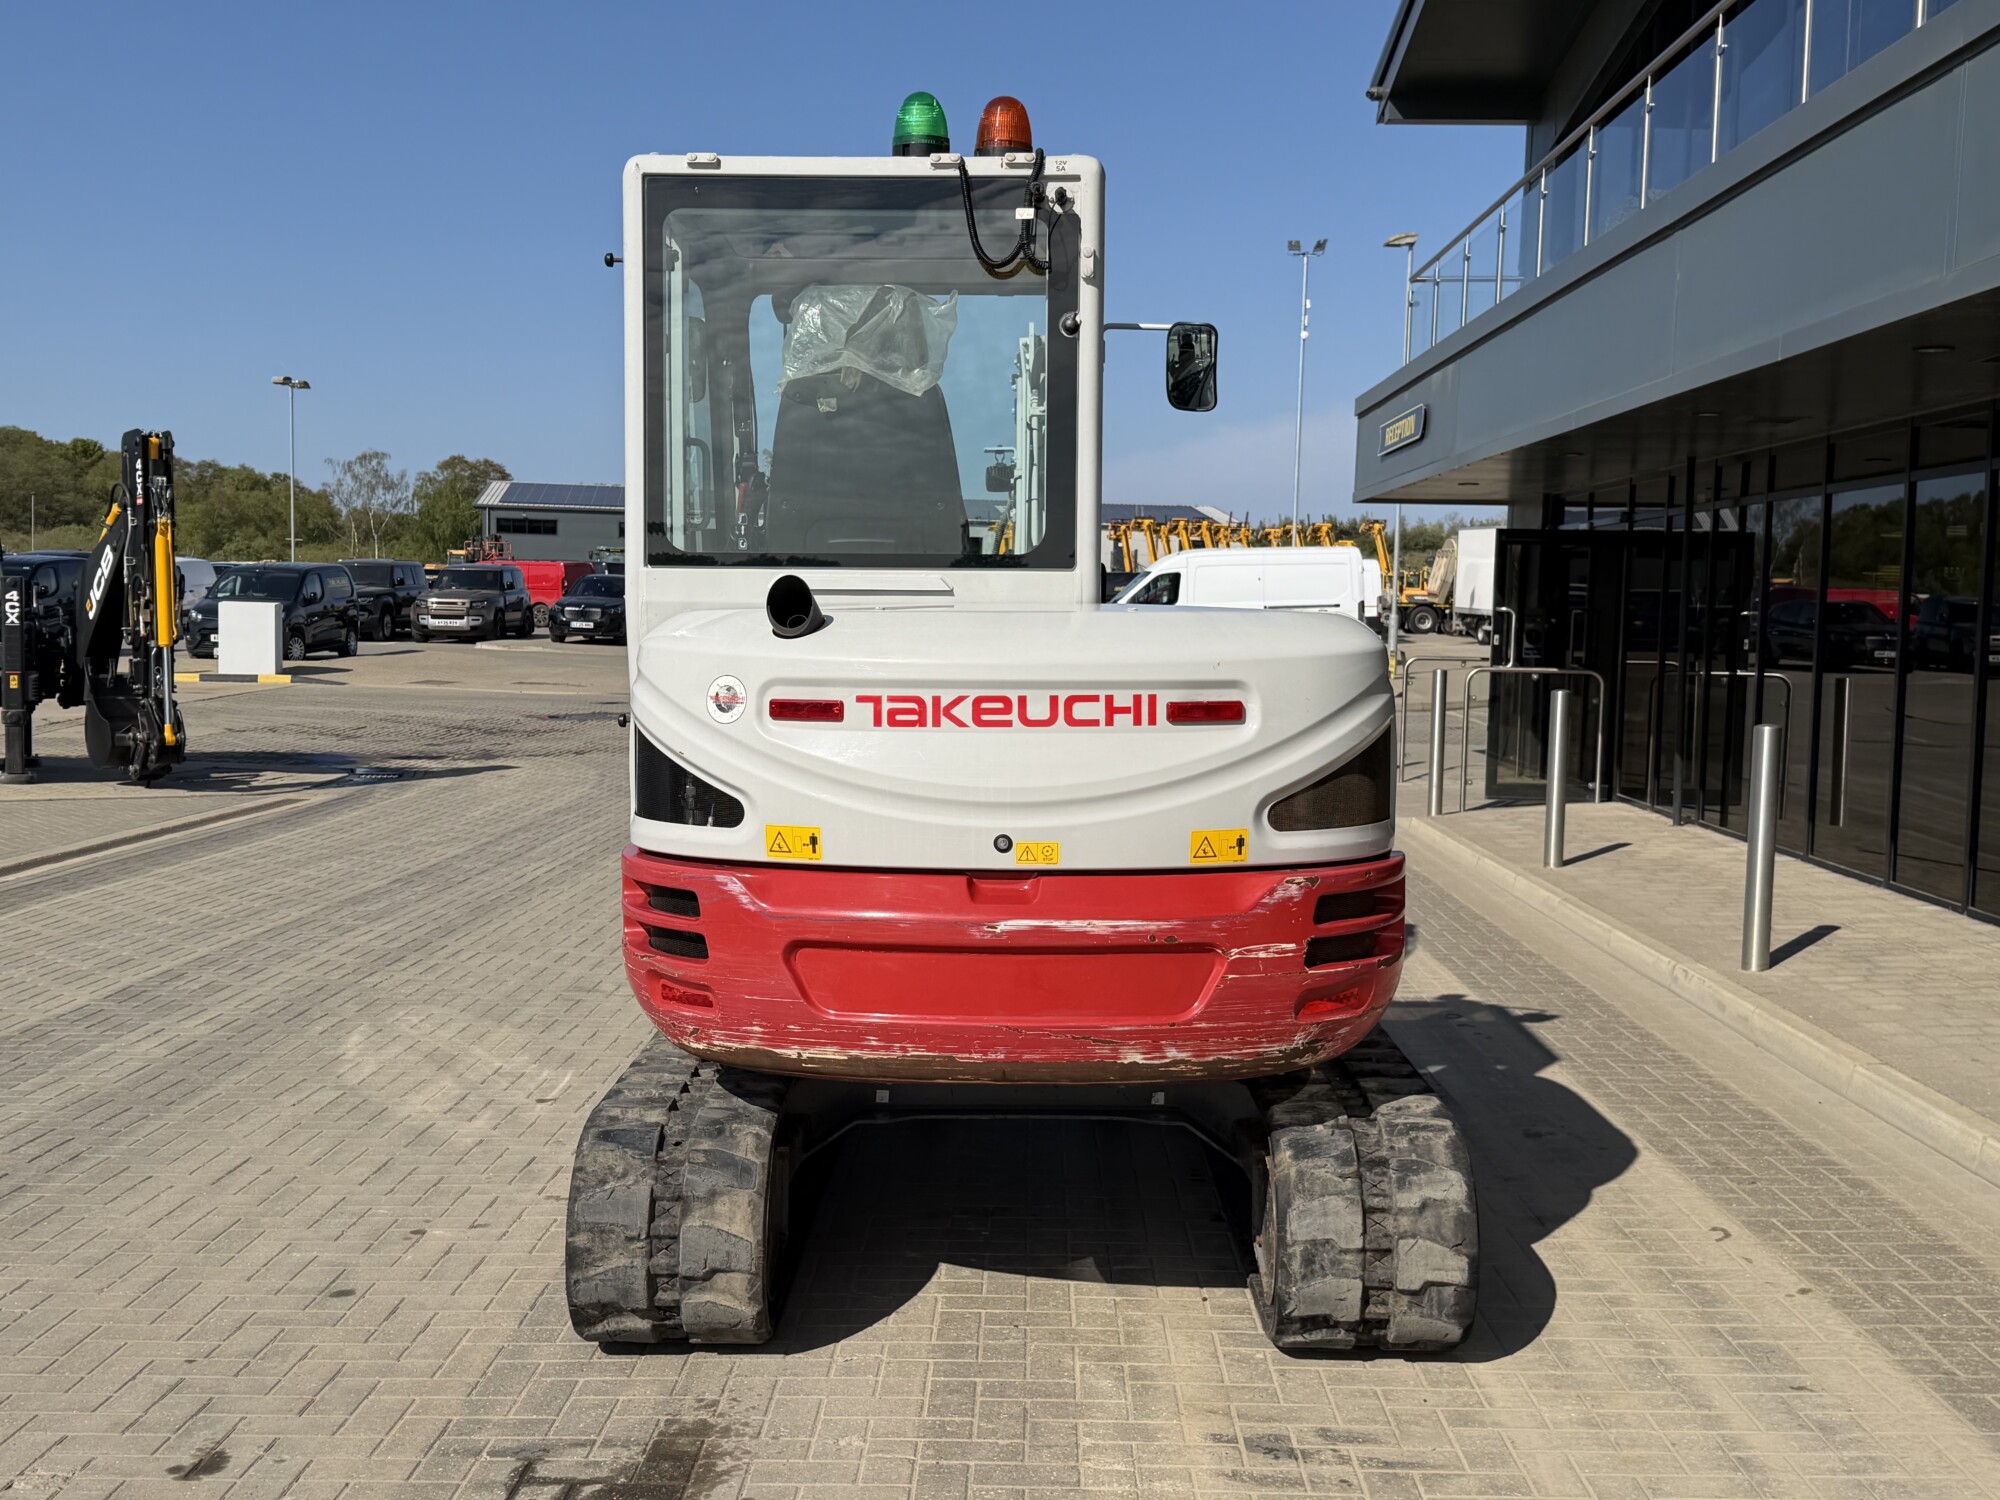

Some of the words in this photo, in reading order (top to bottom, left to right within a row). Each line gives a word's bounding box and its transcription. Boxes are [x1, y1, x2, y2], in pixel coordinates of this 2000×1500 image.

[1385, 413, 1416, 447] RECEPTION
[135, 458, 143, 495] 4CX
[88, 544, 114, 620] JCB
[5, 590, 20, 624] 4CX
